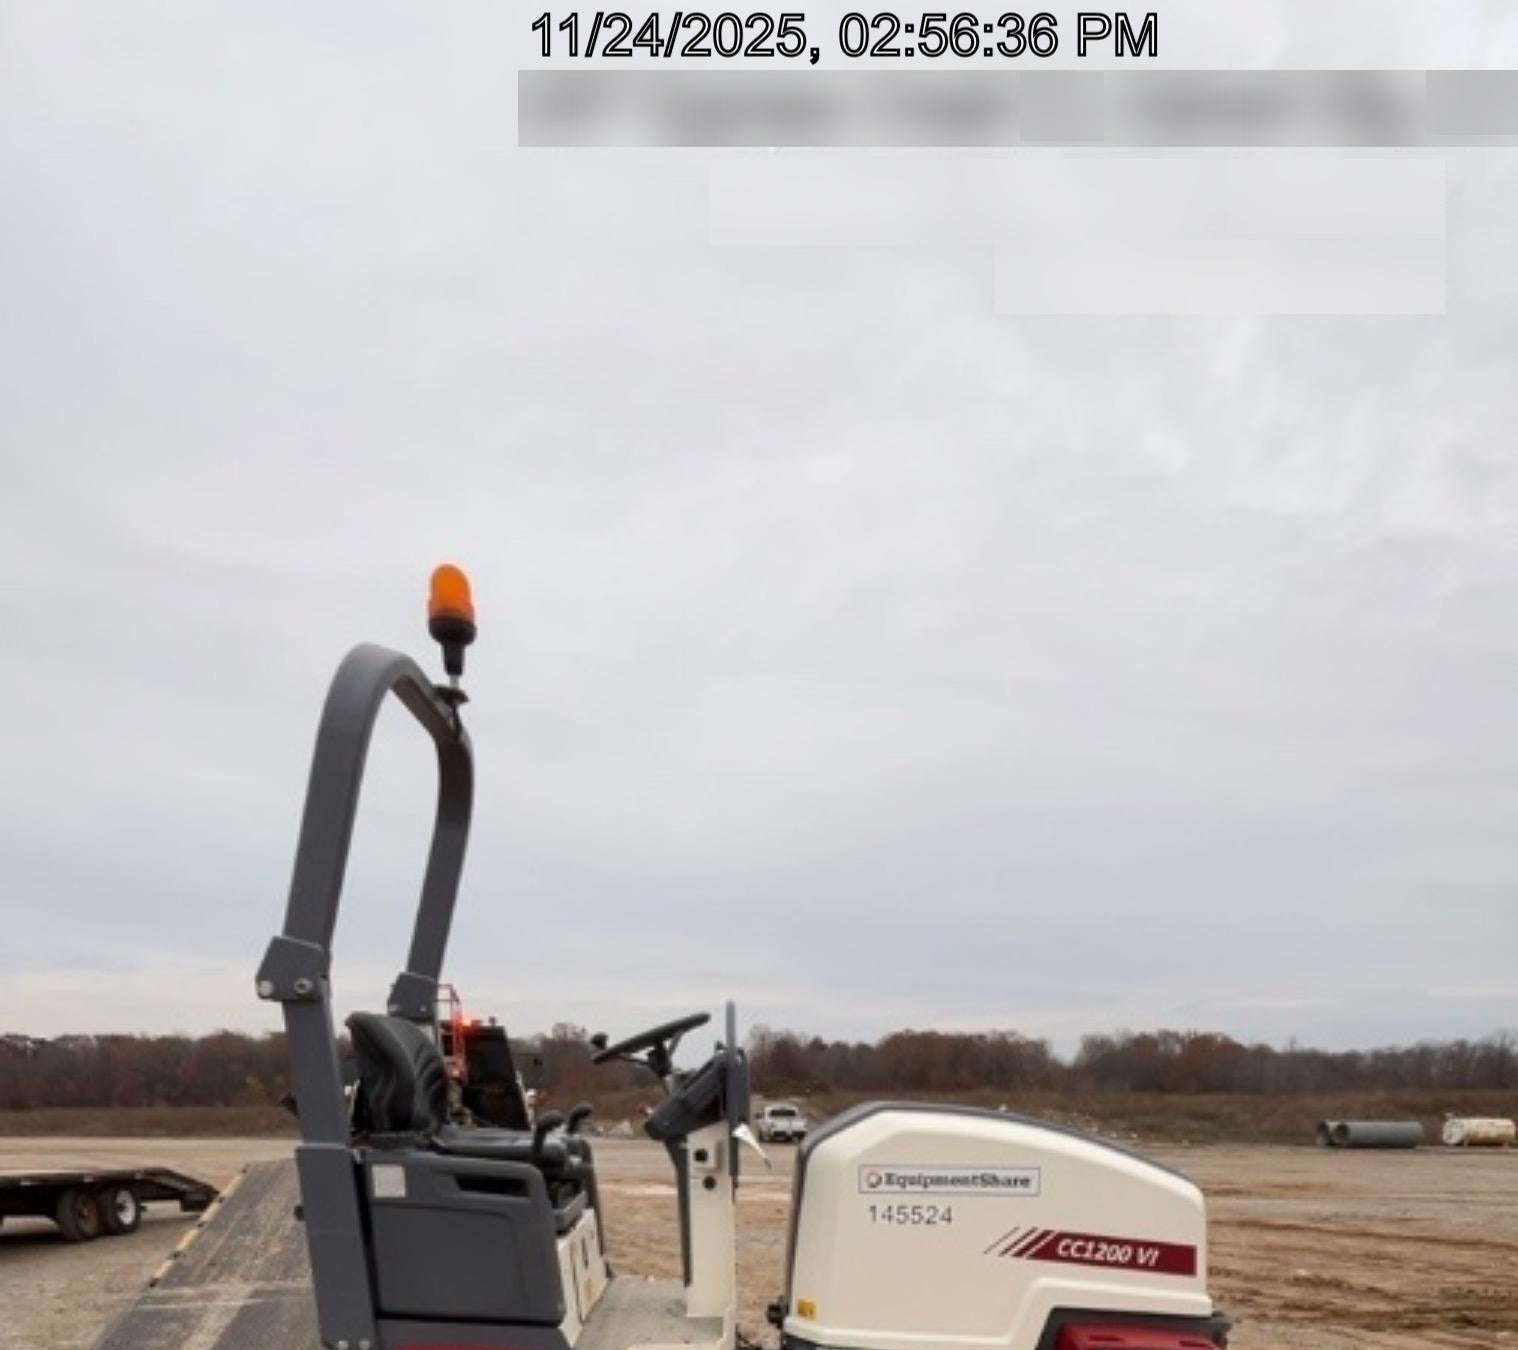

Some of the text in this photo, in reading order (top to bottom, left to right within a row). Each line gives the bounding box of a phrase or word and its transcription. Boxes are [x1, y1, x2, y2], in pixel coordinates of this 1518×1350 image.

[884, 1171, 1031, 1189] EquipmentShare
[868, 1204, 953, 1225] 145524
[1057, 1237, 1133, 1264] CC1200
